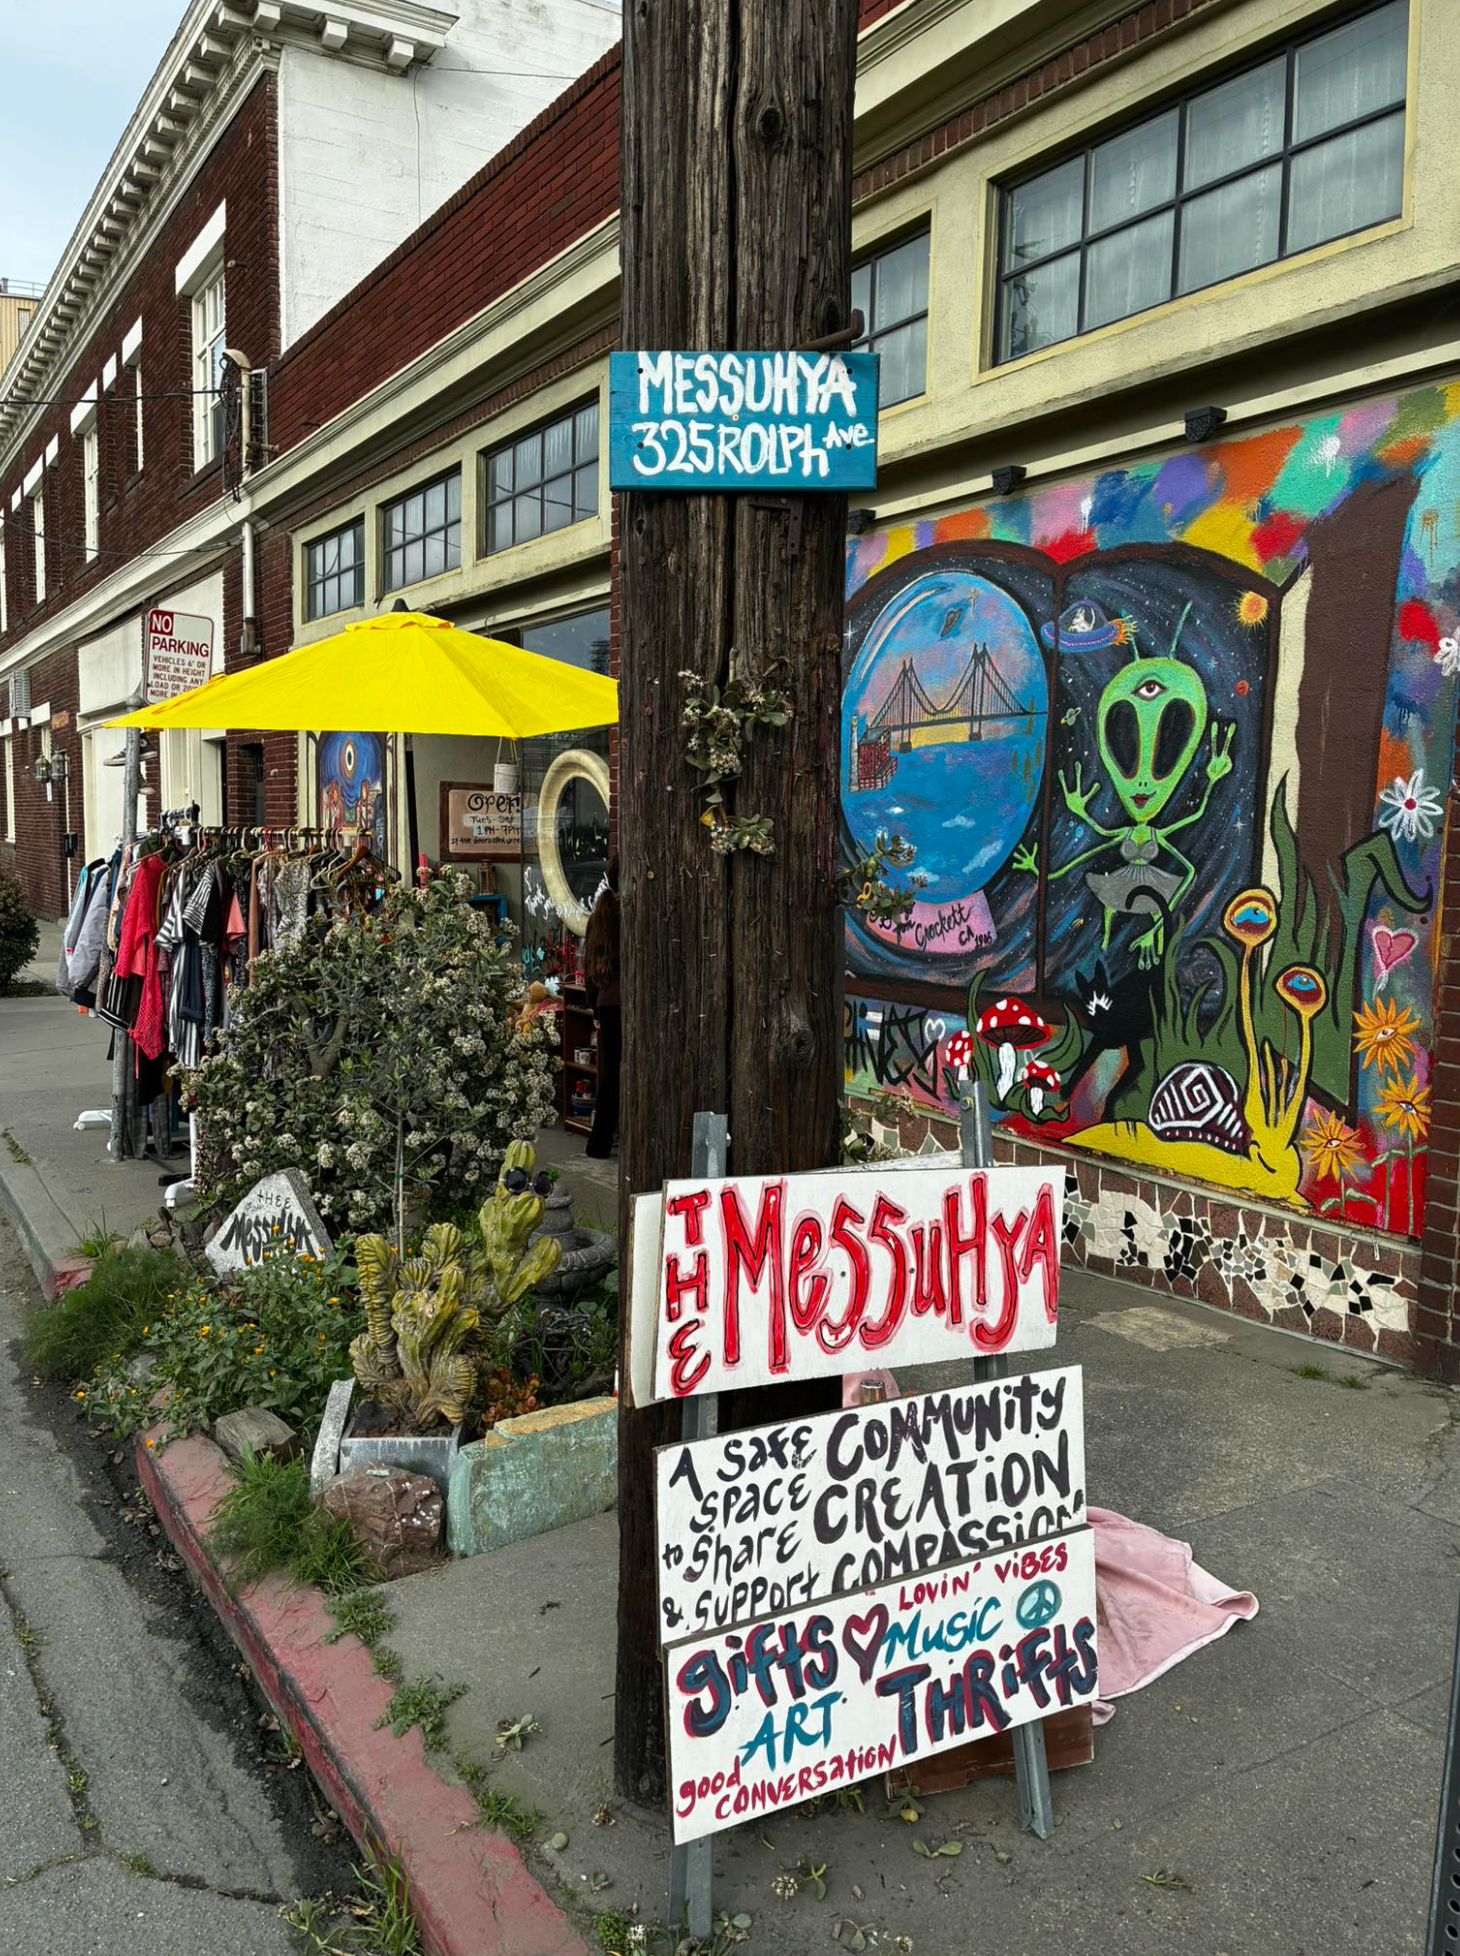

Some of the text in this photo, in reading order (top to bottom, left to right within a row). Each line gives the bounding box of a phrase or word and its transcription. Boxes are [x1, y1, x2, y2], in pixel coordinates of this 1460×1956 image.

[638, 351, 857, 417] MESSUHYA
[632, 419, 714, 476] 325
[152, 614, 172, 633] NO
[152, 637, 209, 657] PARKING
[153, 665, 171, 673] MORE
[182, 668, 205, 677] HEIGHT
[154, 656, 185, 666] VEHICLES
[197, 661, 206, 669] OR
[149, 689, 169, 698] MORE
[151, 681, 169, 689] LOAD
[171, 683, 181, 691] OR
[153, 673, 203, 686] INCLUDING ANY
[915, 903, 974, 949] Crockett
[959, 925, 974, 946] CA
[665, 1187, 712, 1398] THE
[669, 1446, 703, 1502] A
[662, 1543, 684, 1570] to
[662, 1596, 684, 1628] &
[738, 1690, 844, 1772] ART
[675, 1755, 741, 1818] good
